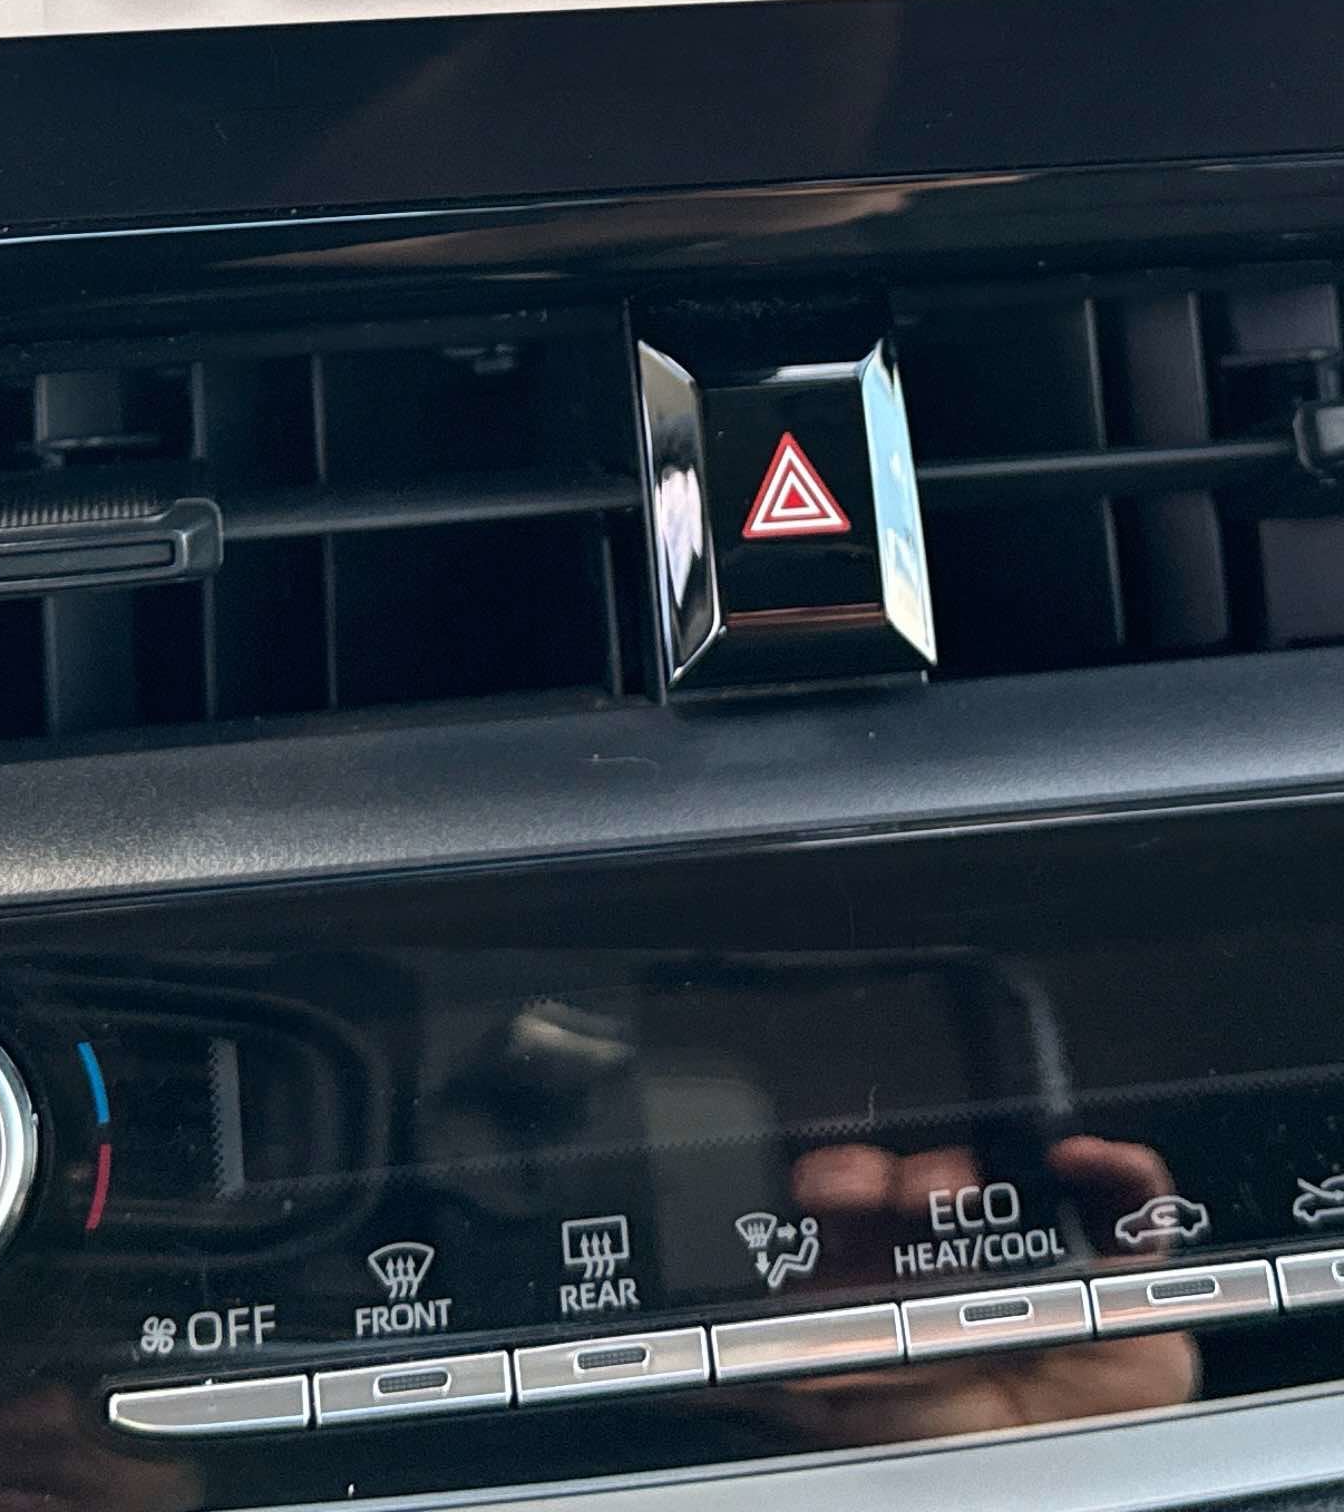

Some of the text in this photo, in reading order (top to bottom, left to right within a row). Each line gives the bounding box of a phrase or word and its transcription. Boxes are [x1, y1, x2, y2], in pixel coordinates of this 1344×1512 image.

[928, 1180, 1021, 1234] ECO
[893, 1227, 1066, 1275] HEAT/COOL
[356, 1296, 453, 1337] FRONT
[559, 1277, 641, 1314] REAR
[187, 1303, 277, 1353] OFF
